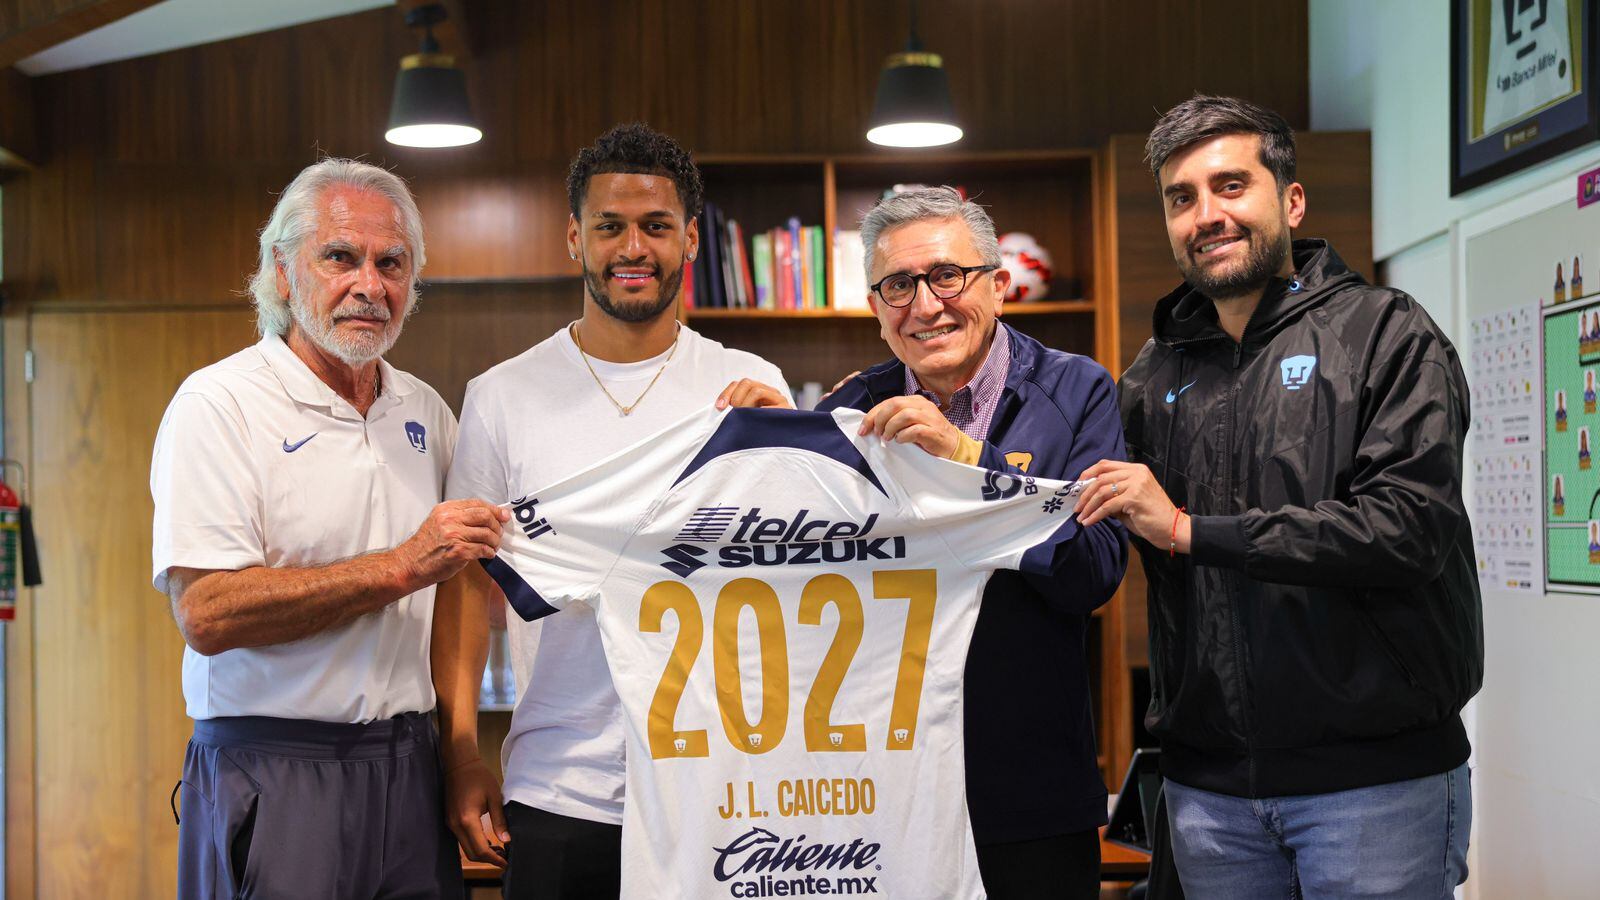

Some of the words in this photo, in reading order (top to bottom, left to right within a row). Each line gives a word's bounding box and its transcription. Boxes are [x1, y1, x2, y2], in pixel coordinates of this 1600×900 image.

[730, 507, 880, 544] telcel
[717, 536, 906, 569] SUZUKI
[639, 569, 937, 760] 2027
[718, 782, 742, 819] J.
[748, 780, 769, 818] L.
[777, 777, 876, 817] CAICEDO
[712, 826, 882, 882] Caliente
[730, 874, 878, 899] caliente.mx
